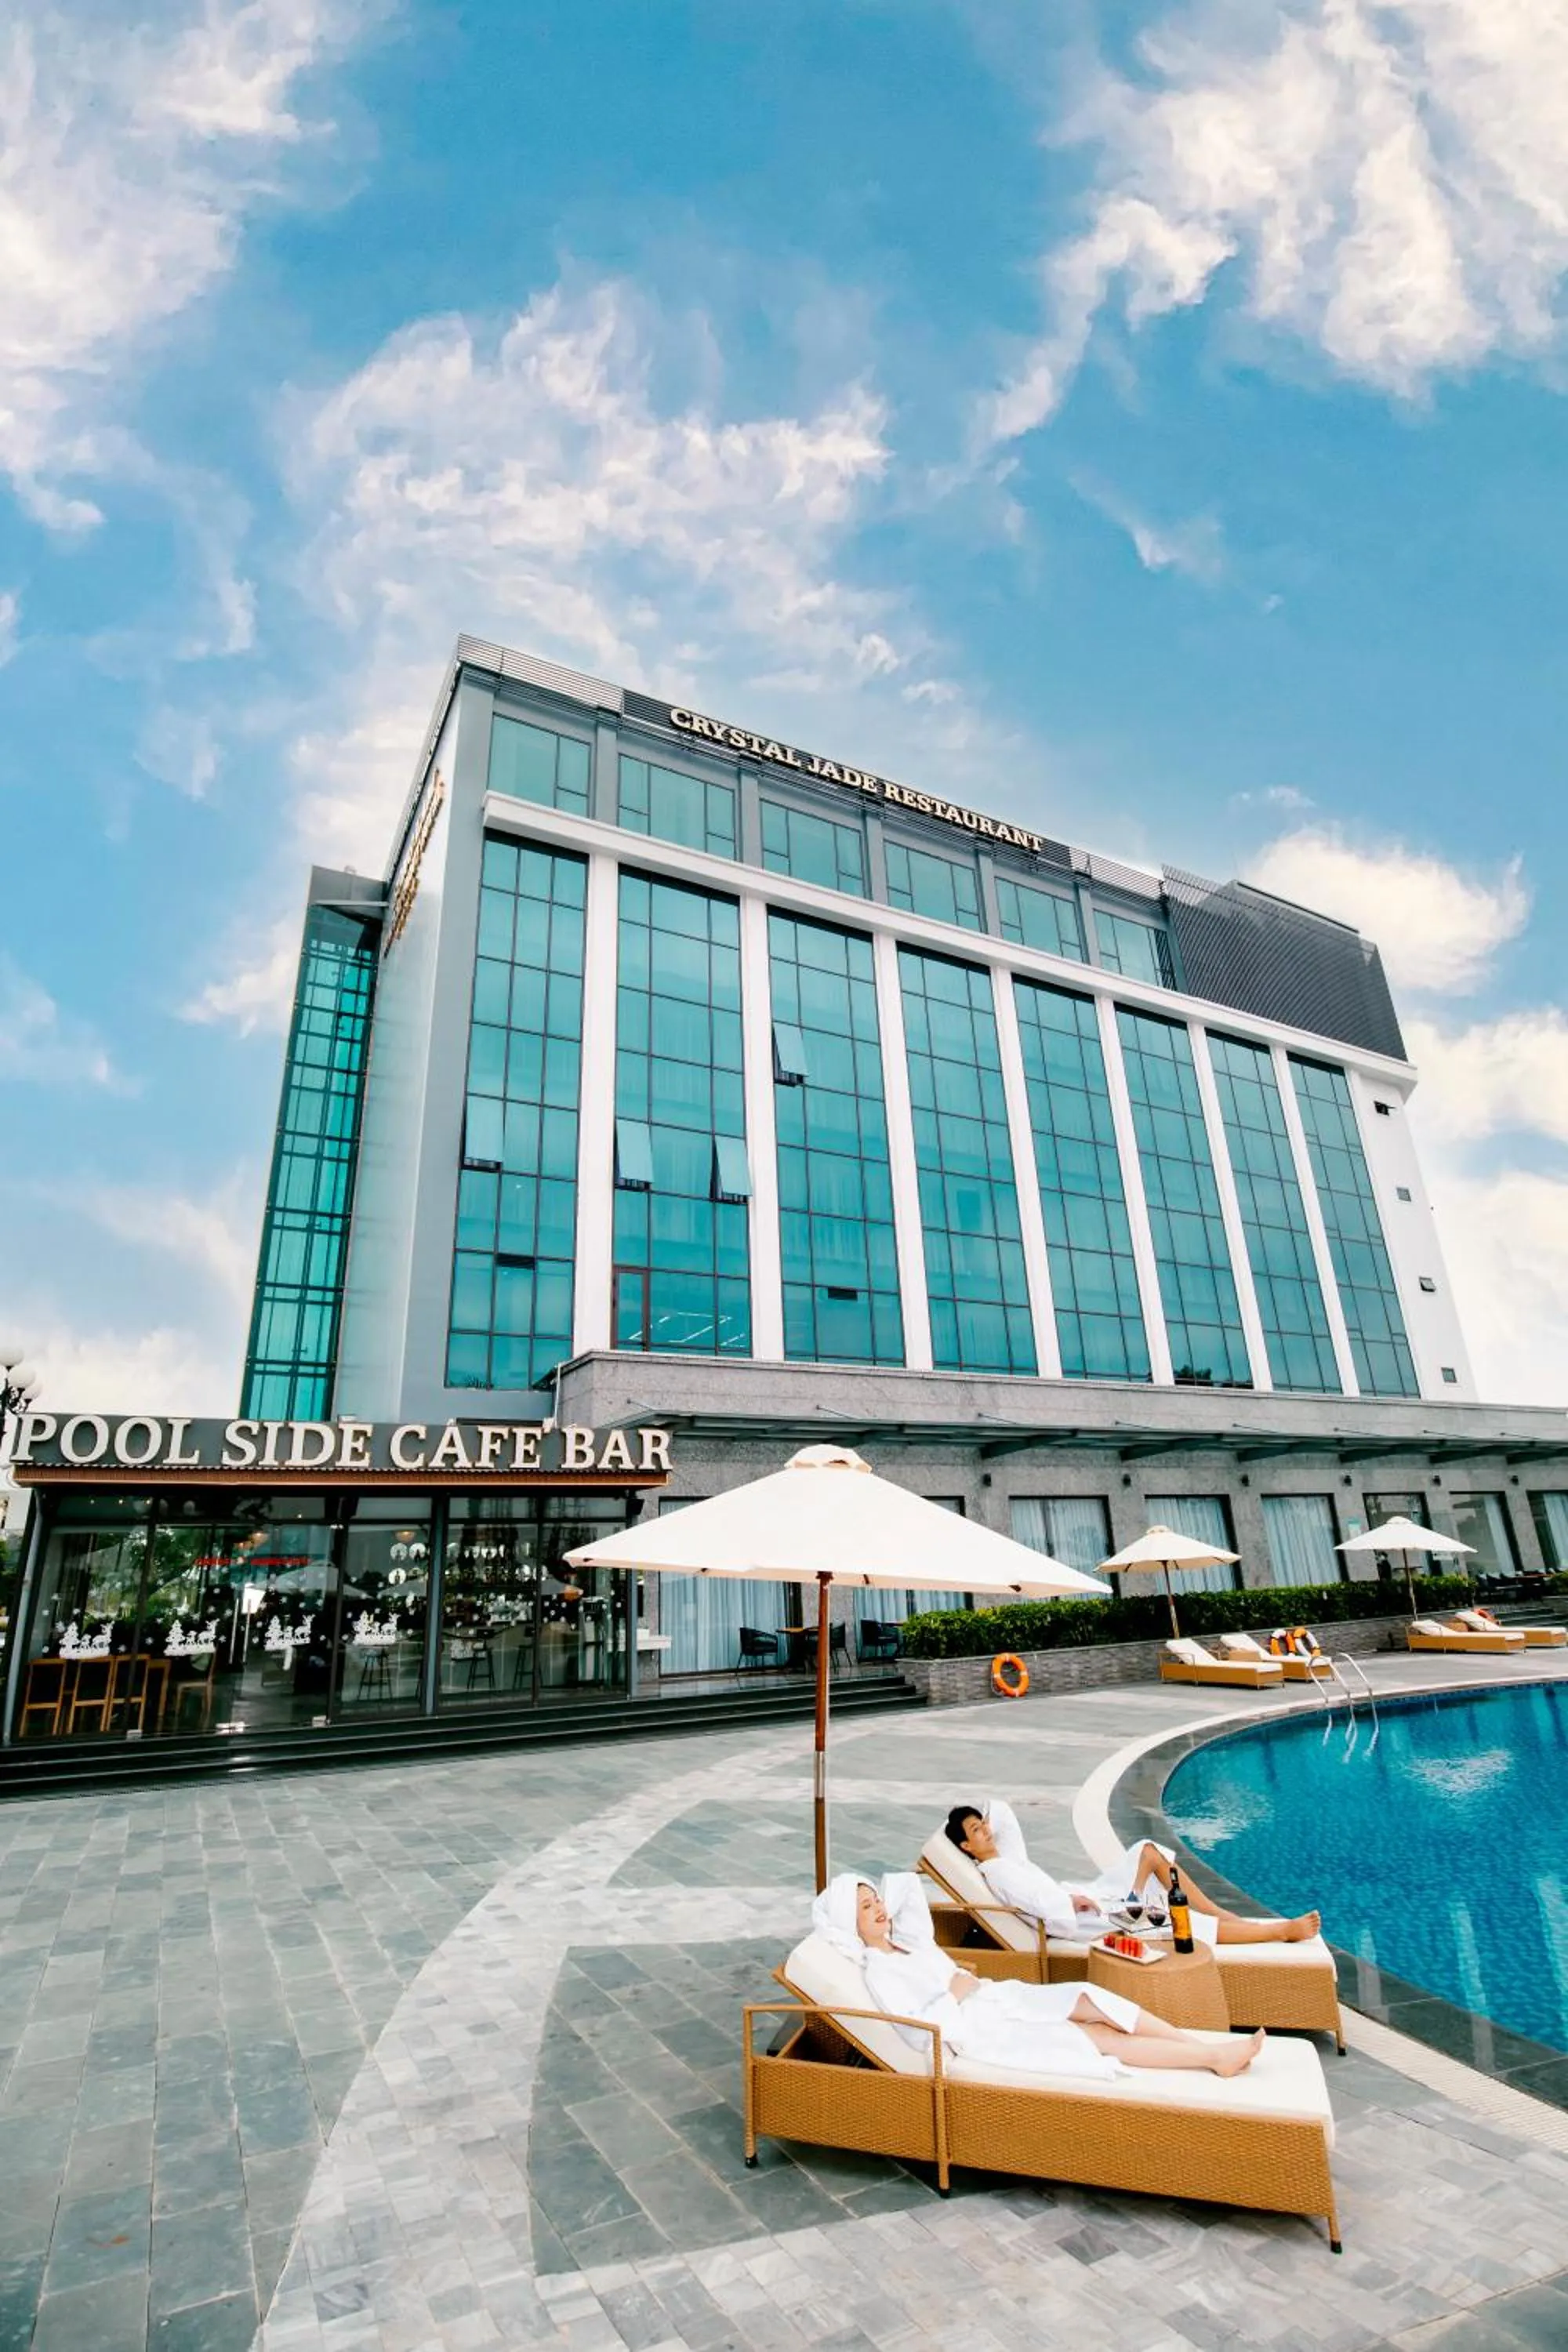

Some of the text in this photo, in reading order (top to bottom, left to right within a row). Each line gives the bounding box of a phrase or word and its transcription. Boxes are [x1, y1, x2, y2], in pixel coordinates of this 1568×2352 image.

[670, 708, 1043, 852] CRYSTAL JADE RESTAURANT
[9, 1414, 200, 1465] POOL
[221, 1420, 373, 1467] SIDE
[561, 1427, 673, 1470] BAR
